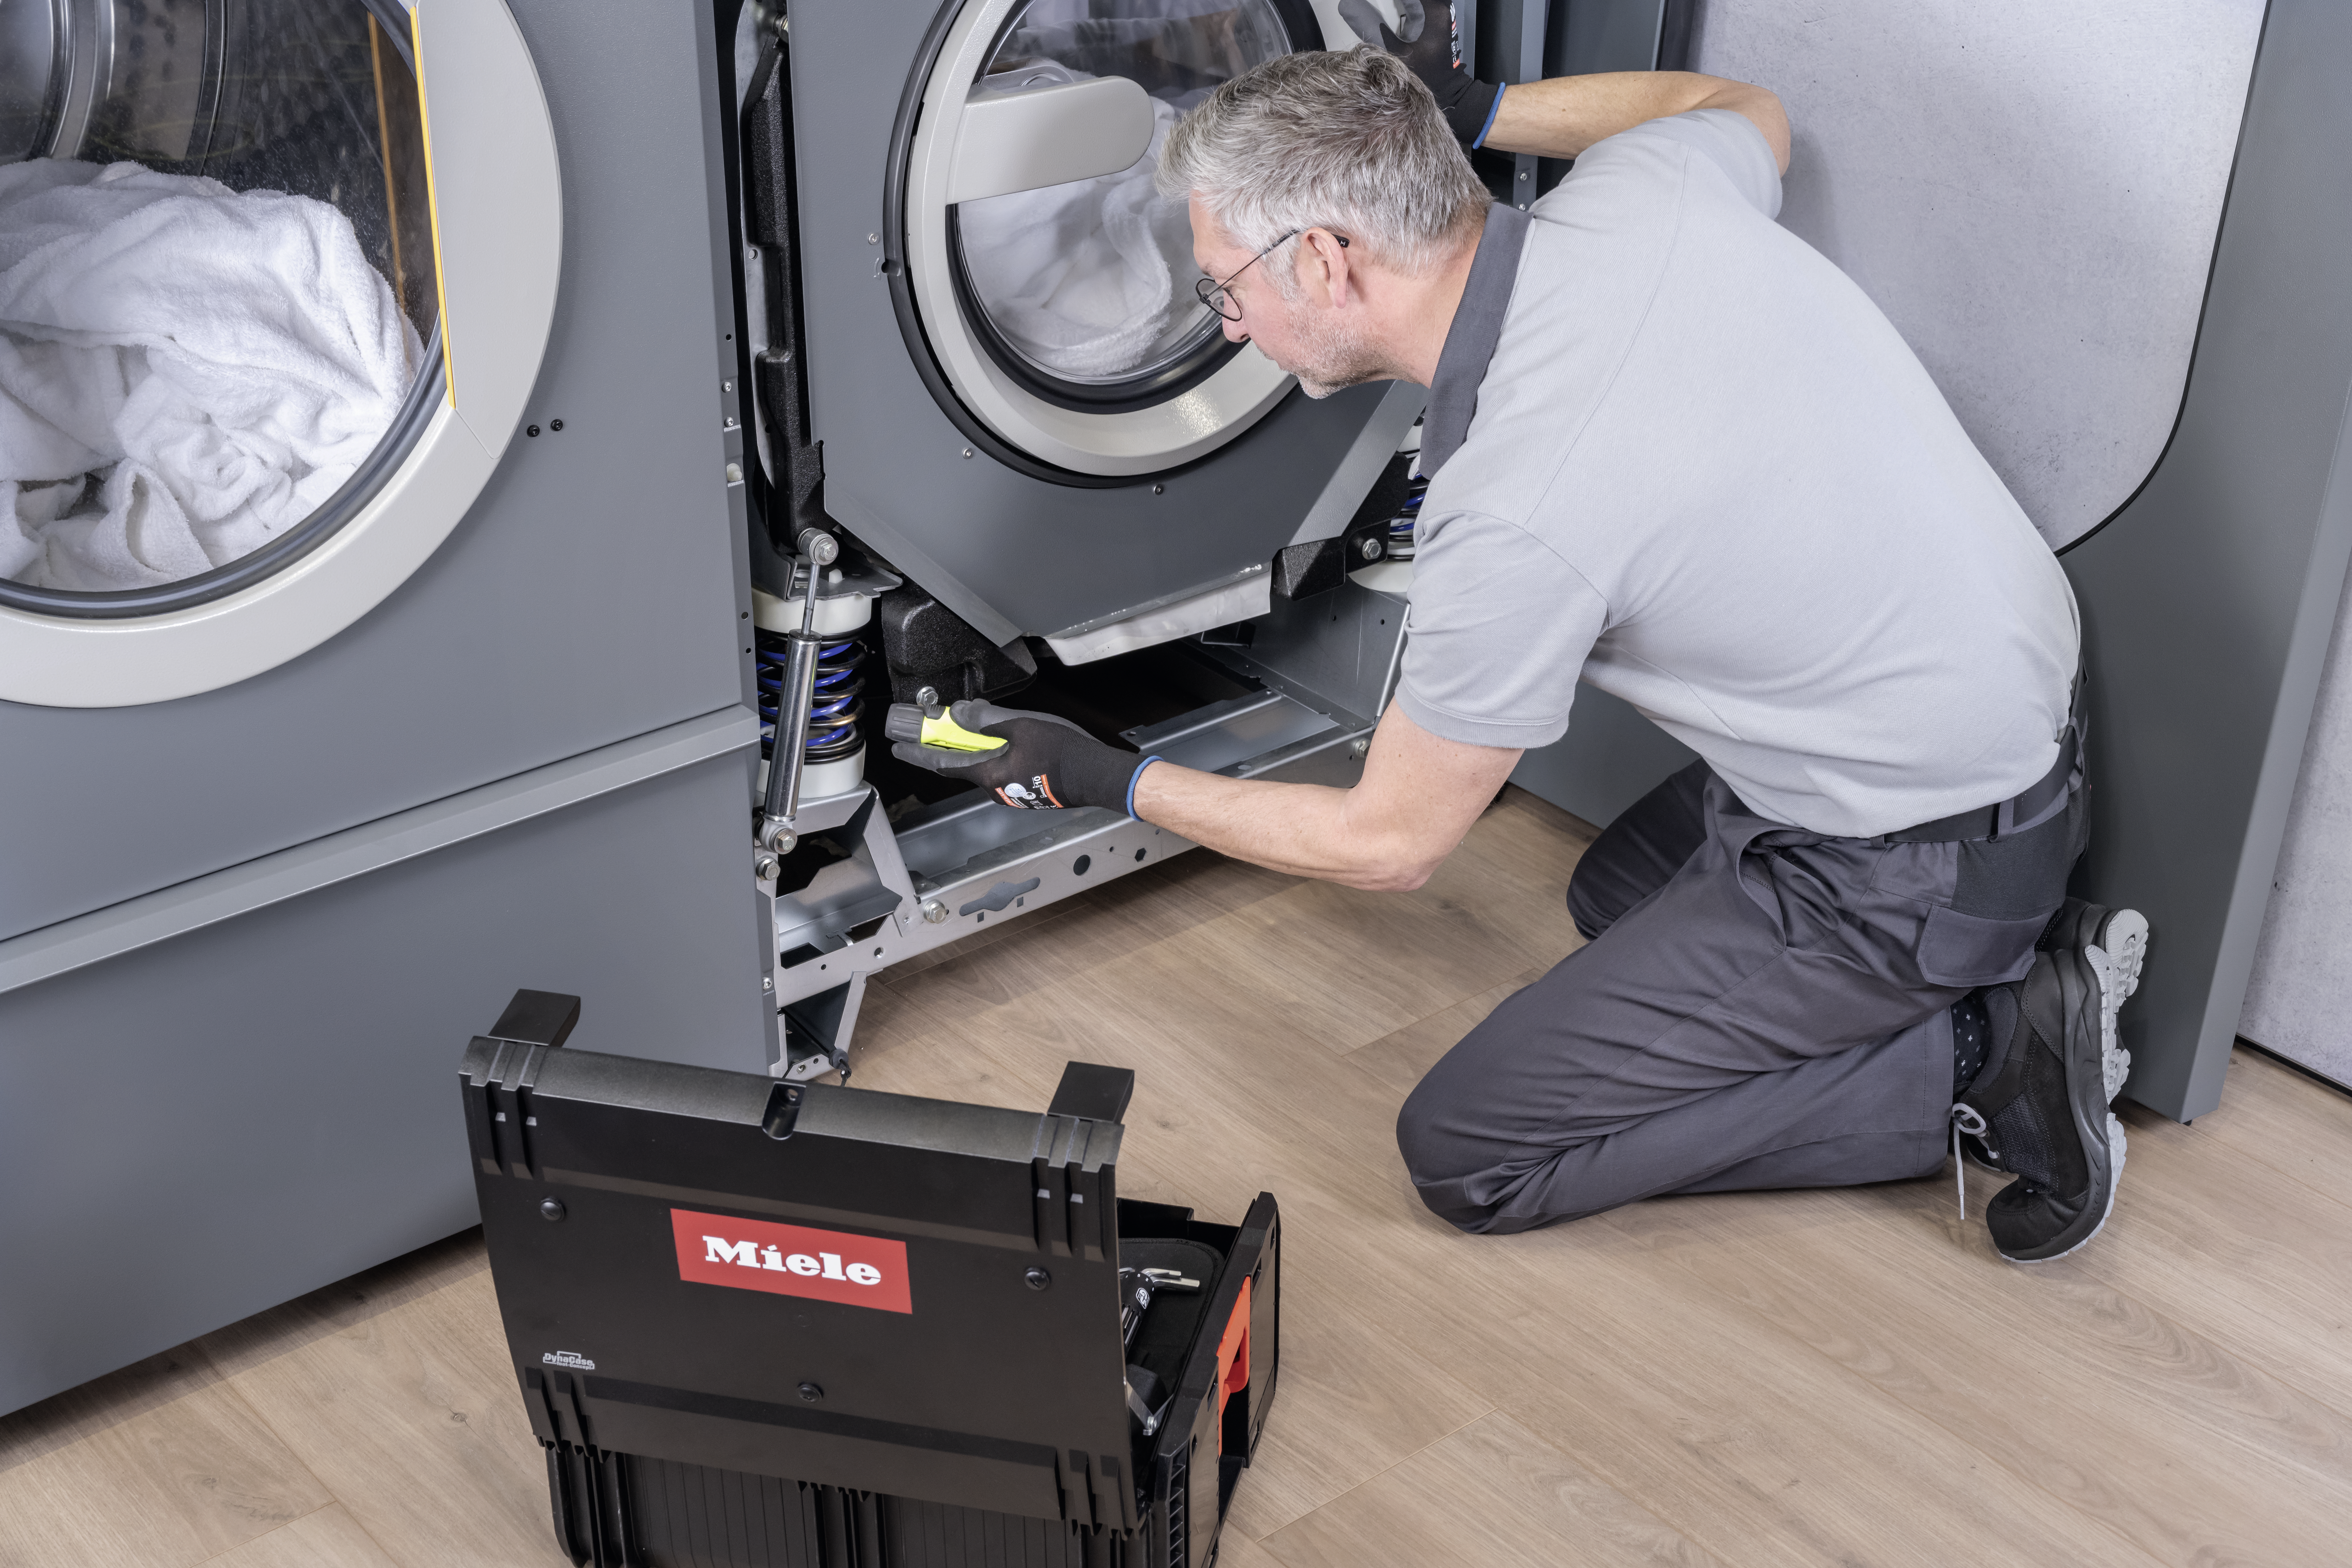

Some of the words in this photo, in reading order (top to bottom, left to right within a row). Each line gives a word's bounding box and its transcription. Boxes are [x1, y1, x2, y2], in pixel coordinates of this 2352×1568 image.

[1034, 776, 1042, 785] 10
[702, 1235, 881, 1285] Miele
[544, 1353, 593, 1366] DynaCase
[556, 1362, 592, 1370] Tool-Concept
